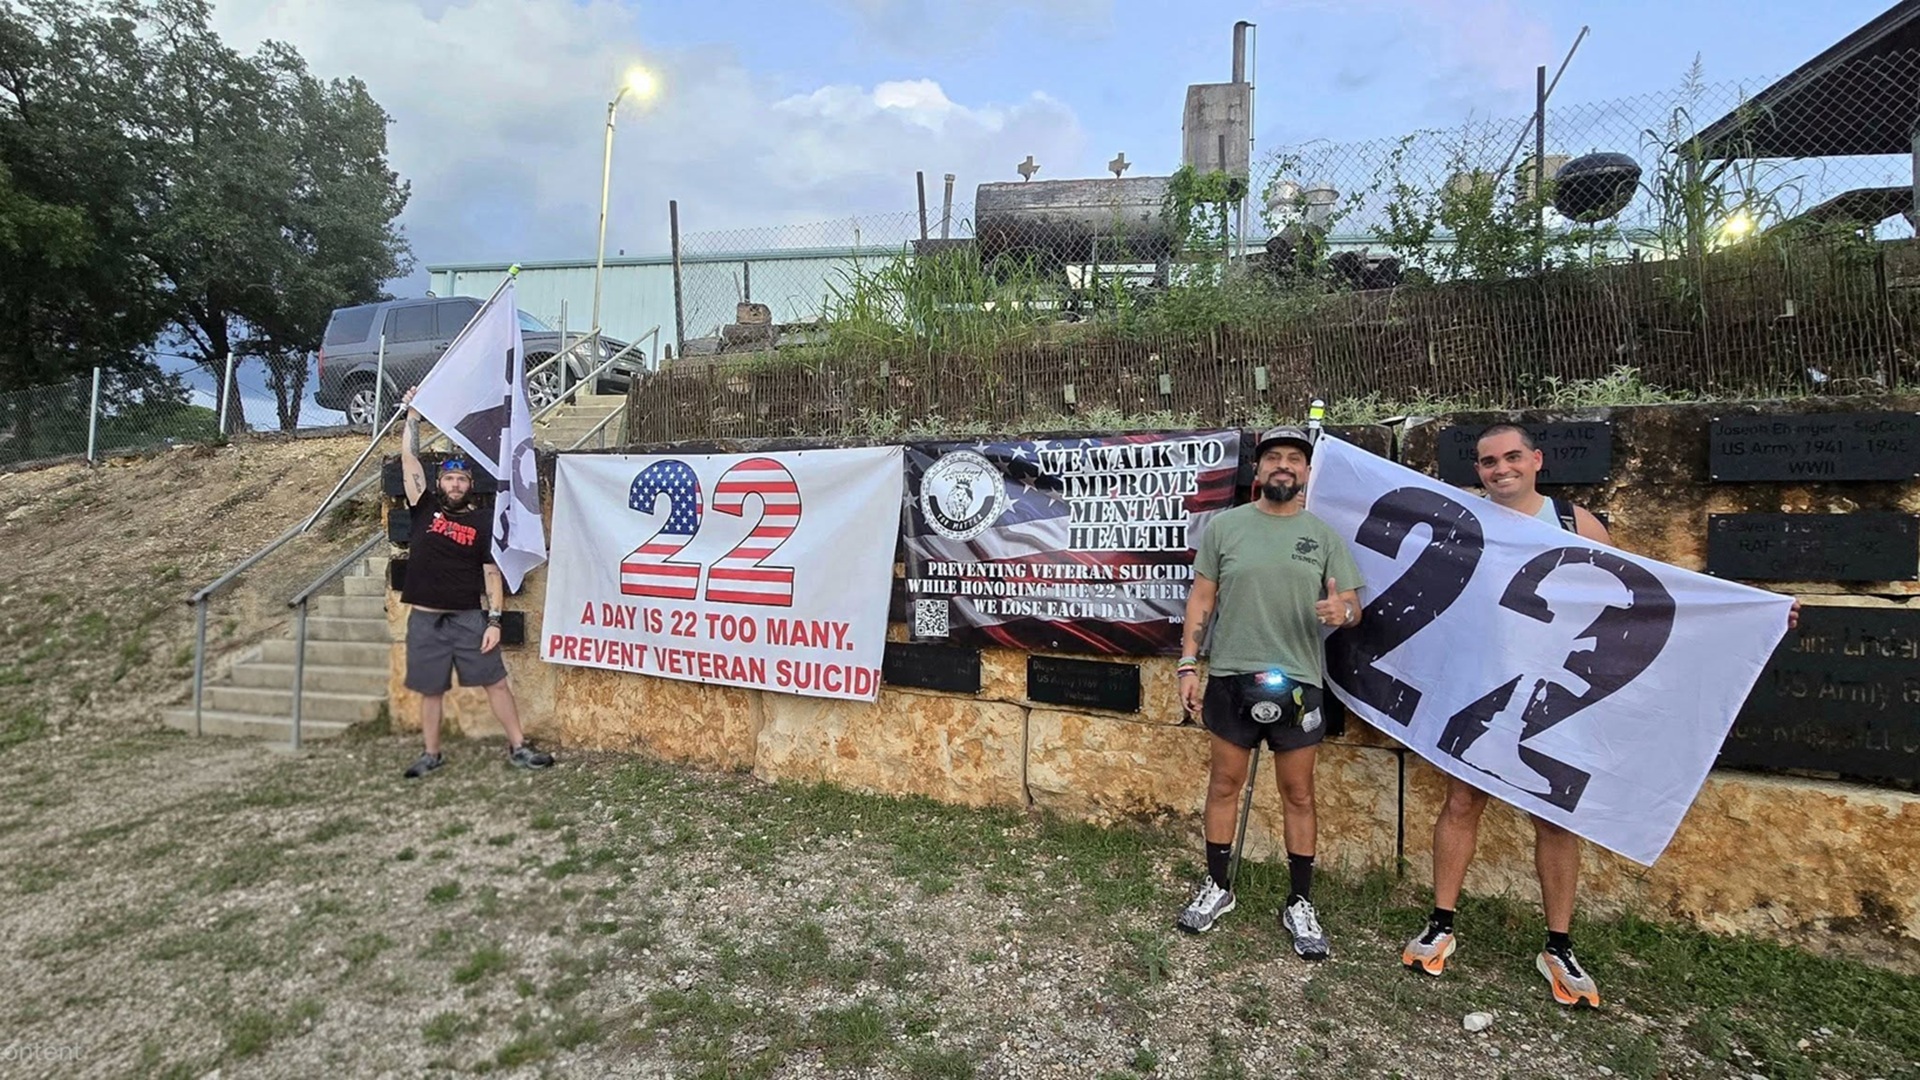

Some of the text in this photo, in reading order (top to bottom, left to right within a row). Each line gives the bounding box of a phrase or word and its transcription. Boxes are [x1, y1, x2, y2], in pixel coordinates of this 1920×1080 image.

[1039, 441, 1223, 474] WE WALK TO
[1552, 446, 1588, 459] 1977
[1721, 441, 1745, 456] US
[1063, 470, 1196, 499] IMPROVE
[1070, 498, 1188, 524] MENTAL
[620, 457, 801, 607] 22
[1068, 525, 1187, 550] HEALTH
[928, 562, 1026, 578] PREVENTING
[1032, 563, 1114, 580] VETERAN
[907, 579, 1192, 600] WHILE HONORING THE 22 VETER
[972, 599, 1138, 619] WE LOSE EACH DAY
[581, 602, 854, 651] A DAY IS 22 TOO MANY.
[549, 634, 648, 669] PREVENT
[653, 646, 766, 684] VETERAN
[1324, 486, 1676, 814] 22
